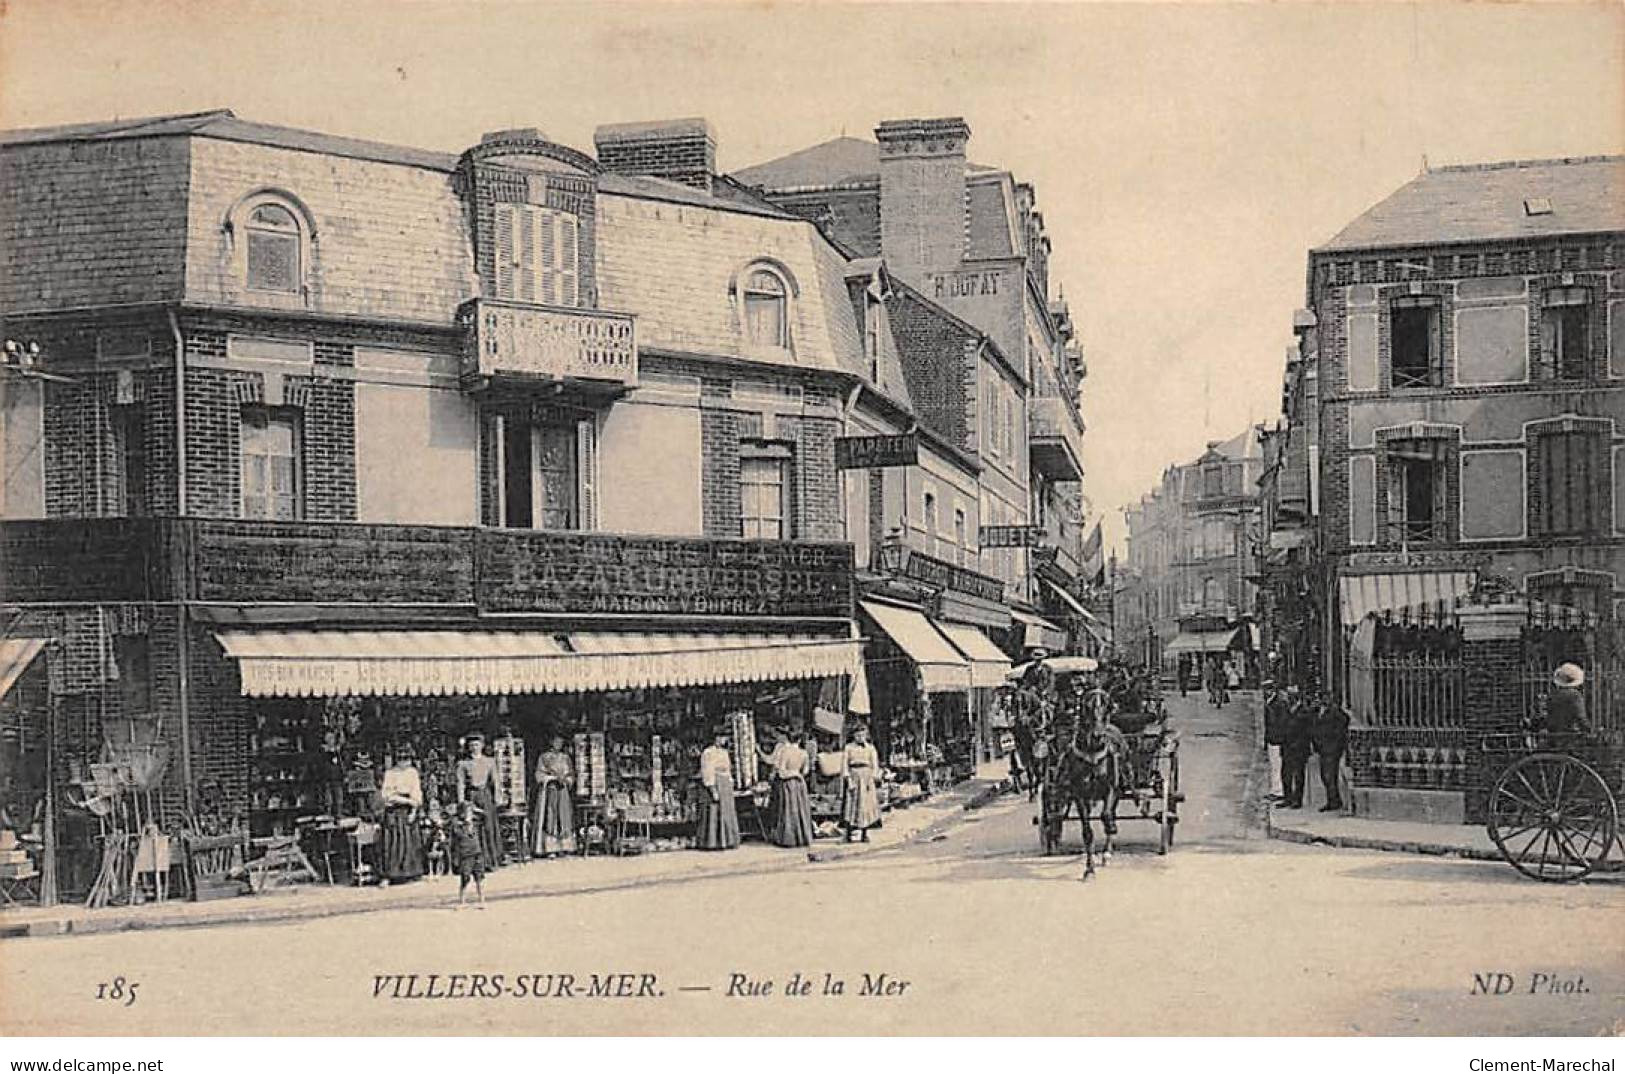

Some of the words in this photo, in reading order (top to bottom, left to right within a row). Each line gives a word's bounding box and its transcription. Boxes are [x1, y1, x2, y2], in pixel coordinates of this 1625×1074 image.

[980, 528, 1039, 547] JOUETS
[645, 566, 824, 595] UNIVERSEL
[591, 594, 672, 612] MAISON
